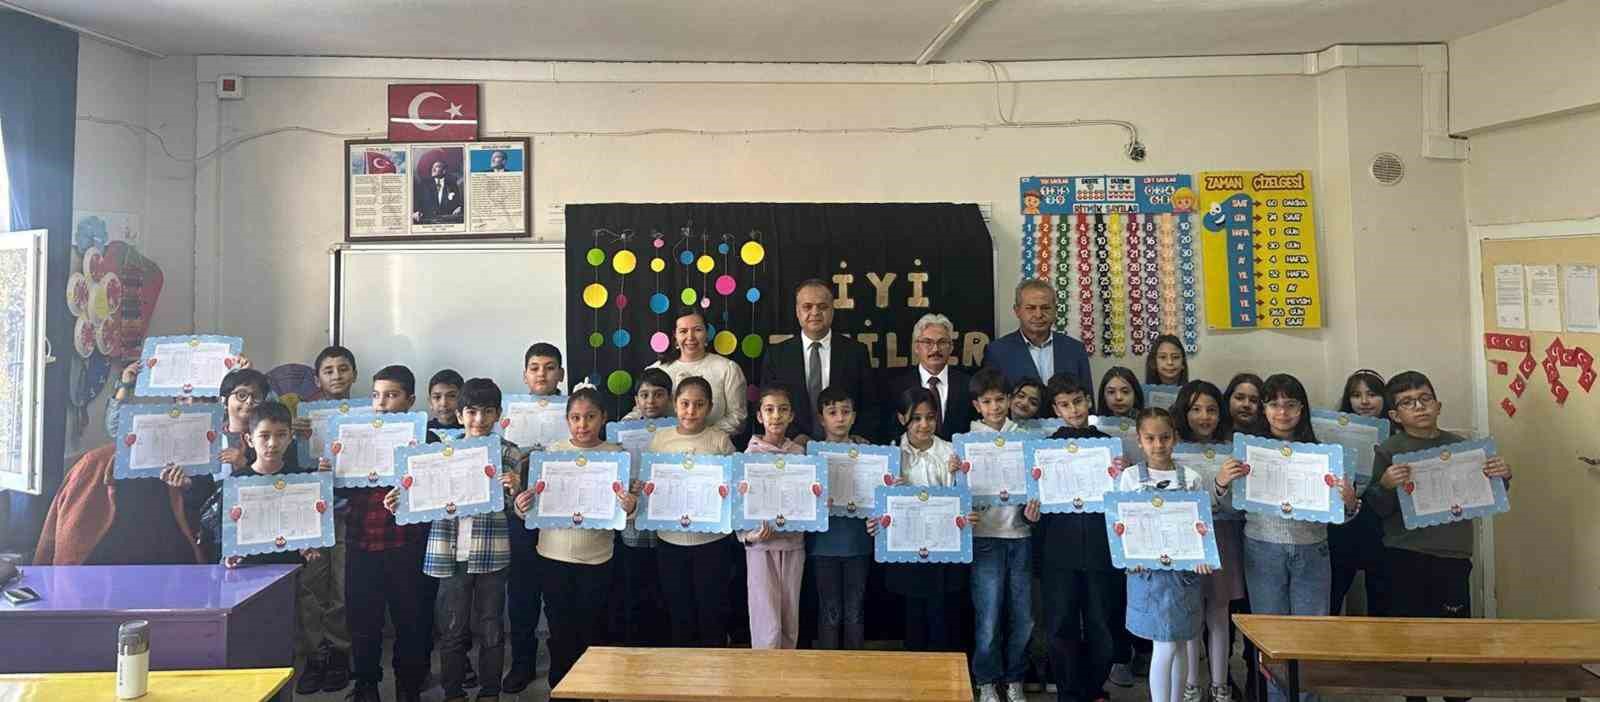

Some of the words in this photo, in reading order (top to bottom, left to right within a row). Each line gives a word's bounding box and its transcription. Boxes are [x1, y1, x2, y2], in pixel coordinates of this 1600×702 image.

[1205, 176, 1243, 190] ZAMAN
[1252, 174, 1304, 191] ÇİZELGESİ
[1266, 199, 1278, 207] 60
[1267, 213, 1278, 221] 24
[1283, 213, 1302, 221] SAAT
[1180, 222, 1189, 230] 10
[1284, 227, 1300, 235] GÜN
[1097, 237, 1106, 245] 10
[1147, 237, 1155, 245] 16
[1181, 235, 1191, 243] 20
[1285, 241, 1301, 249] GÜN
[1080, 250, 1088, 258] 12
[1130, 249, 1138, 258] 21
[1146, 250, 1155, 258] 24
[1182, 249, 1192, 257] 30
[1080, 263, 1089, 271] 16
[1100, 264, 1108, 272] 20
[1130, 263, 1139, 271] 28
[1146, 264, 1156, 272] 32
[1286, 270, 1309, 278] HAFTA
[832, 259, 929, 309] İYİ
[1081, 277, 1091, 285] 20
[1130, 277, 1140, 285] 35
[1146, 277, 1157, 285] 40
[1183, 276, 1194, 284] 50
[1287, 284, 1296, 292] AY
[1082, 290, 1091, 299] 24
[1131, 290, 1140, 298] 42
[1147, 290, 1157, 299] 48
[1183, 289, 1194, 297] 60
[1057, 304, 1065, 312] 21
[1148, 304, 1159, 312] 56
[1184, 303, 1194, 311] 70
[1289, 308, 1305, 316] GÜN
[1133, 317, 1143, 325] 56
[1148, 317, 1159, 325] 64
[1286, 318, 1304, 326] SAAT
[1133, 330, 1143, 339] 63
[1134, 344, 1144, 352] 70
